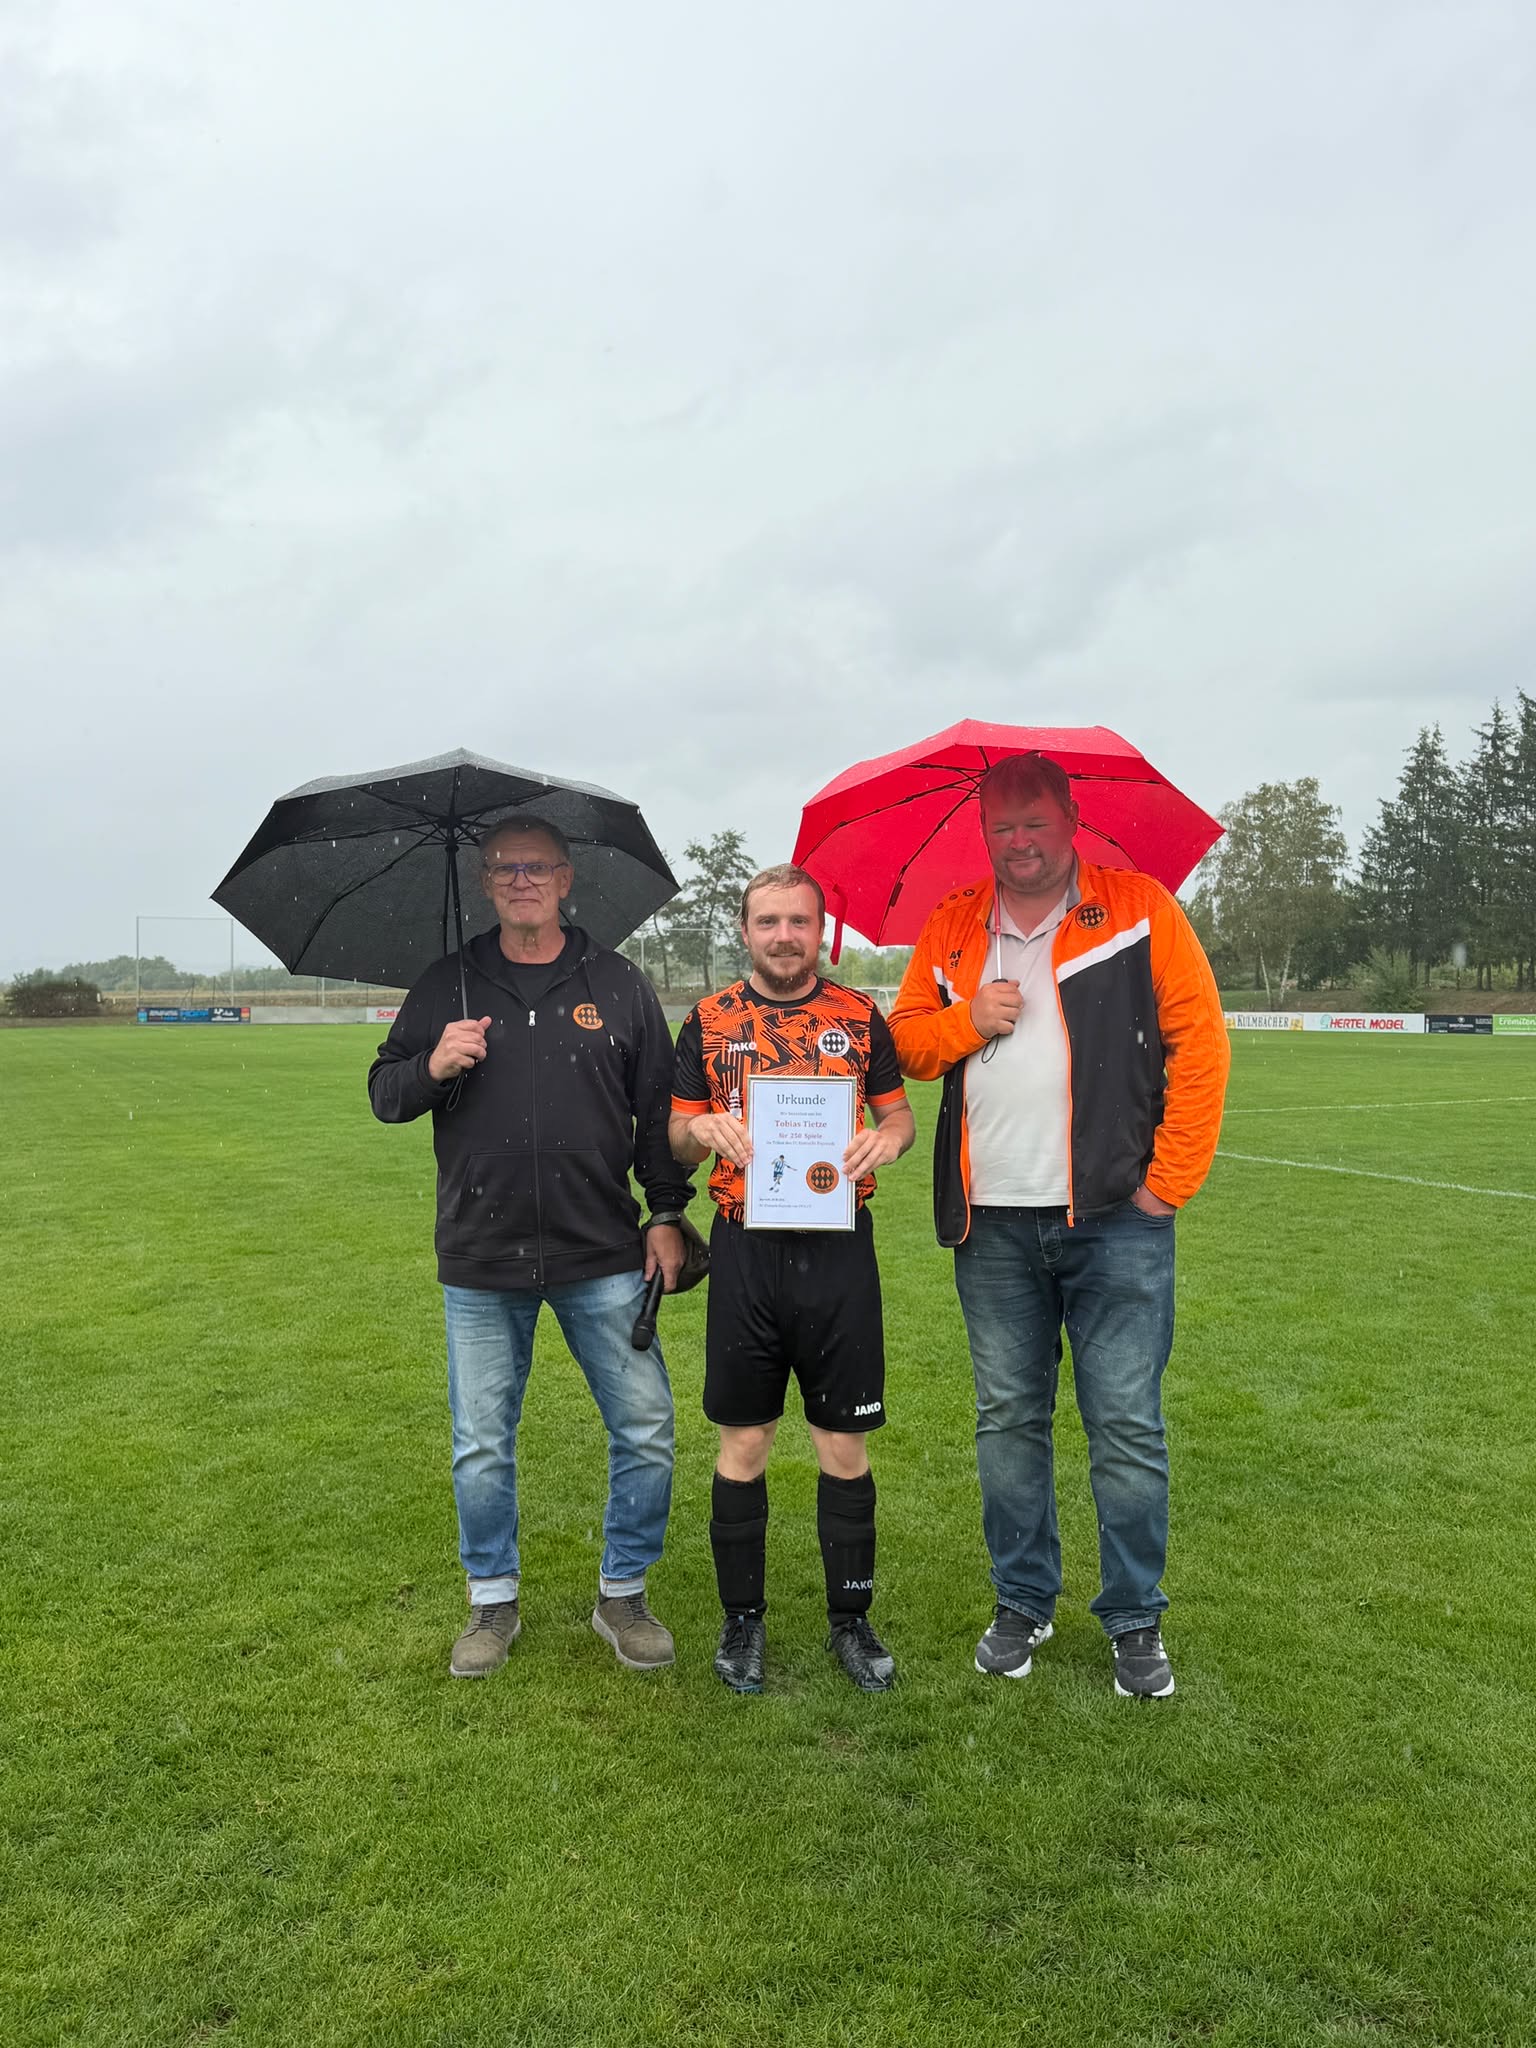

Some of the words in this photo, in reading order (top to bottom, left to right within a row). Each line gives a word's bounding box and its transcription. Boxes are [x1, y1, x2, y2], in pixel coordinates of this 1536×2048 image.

[1237, 1014, 1289, 1028] KULMBACHER
[1330, 1018, 1366, 1029] HERTEL
[728, 1042, 757, 1053] JAKO
[776, 1094, 826, 1106] Urkunde
[774, 1119, 801, 1128] Tobias
[803, 1120, 827, 1128] Tietze
[854, 1401, 881, 1416] JAKO
[842, 1579, 873, 1590] JAKO
